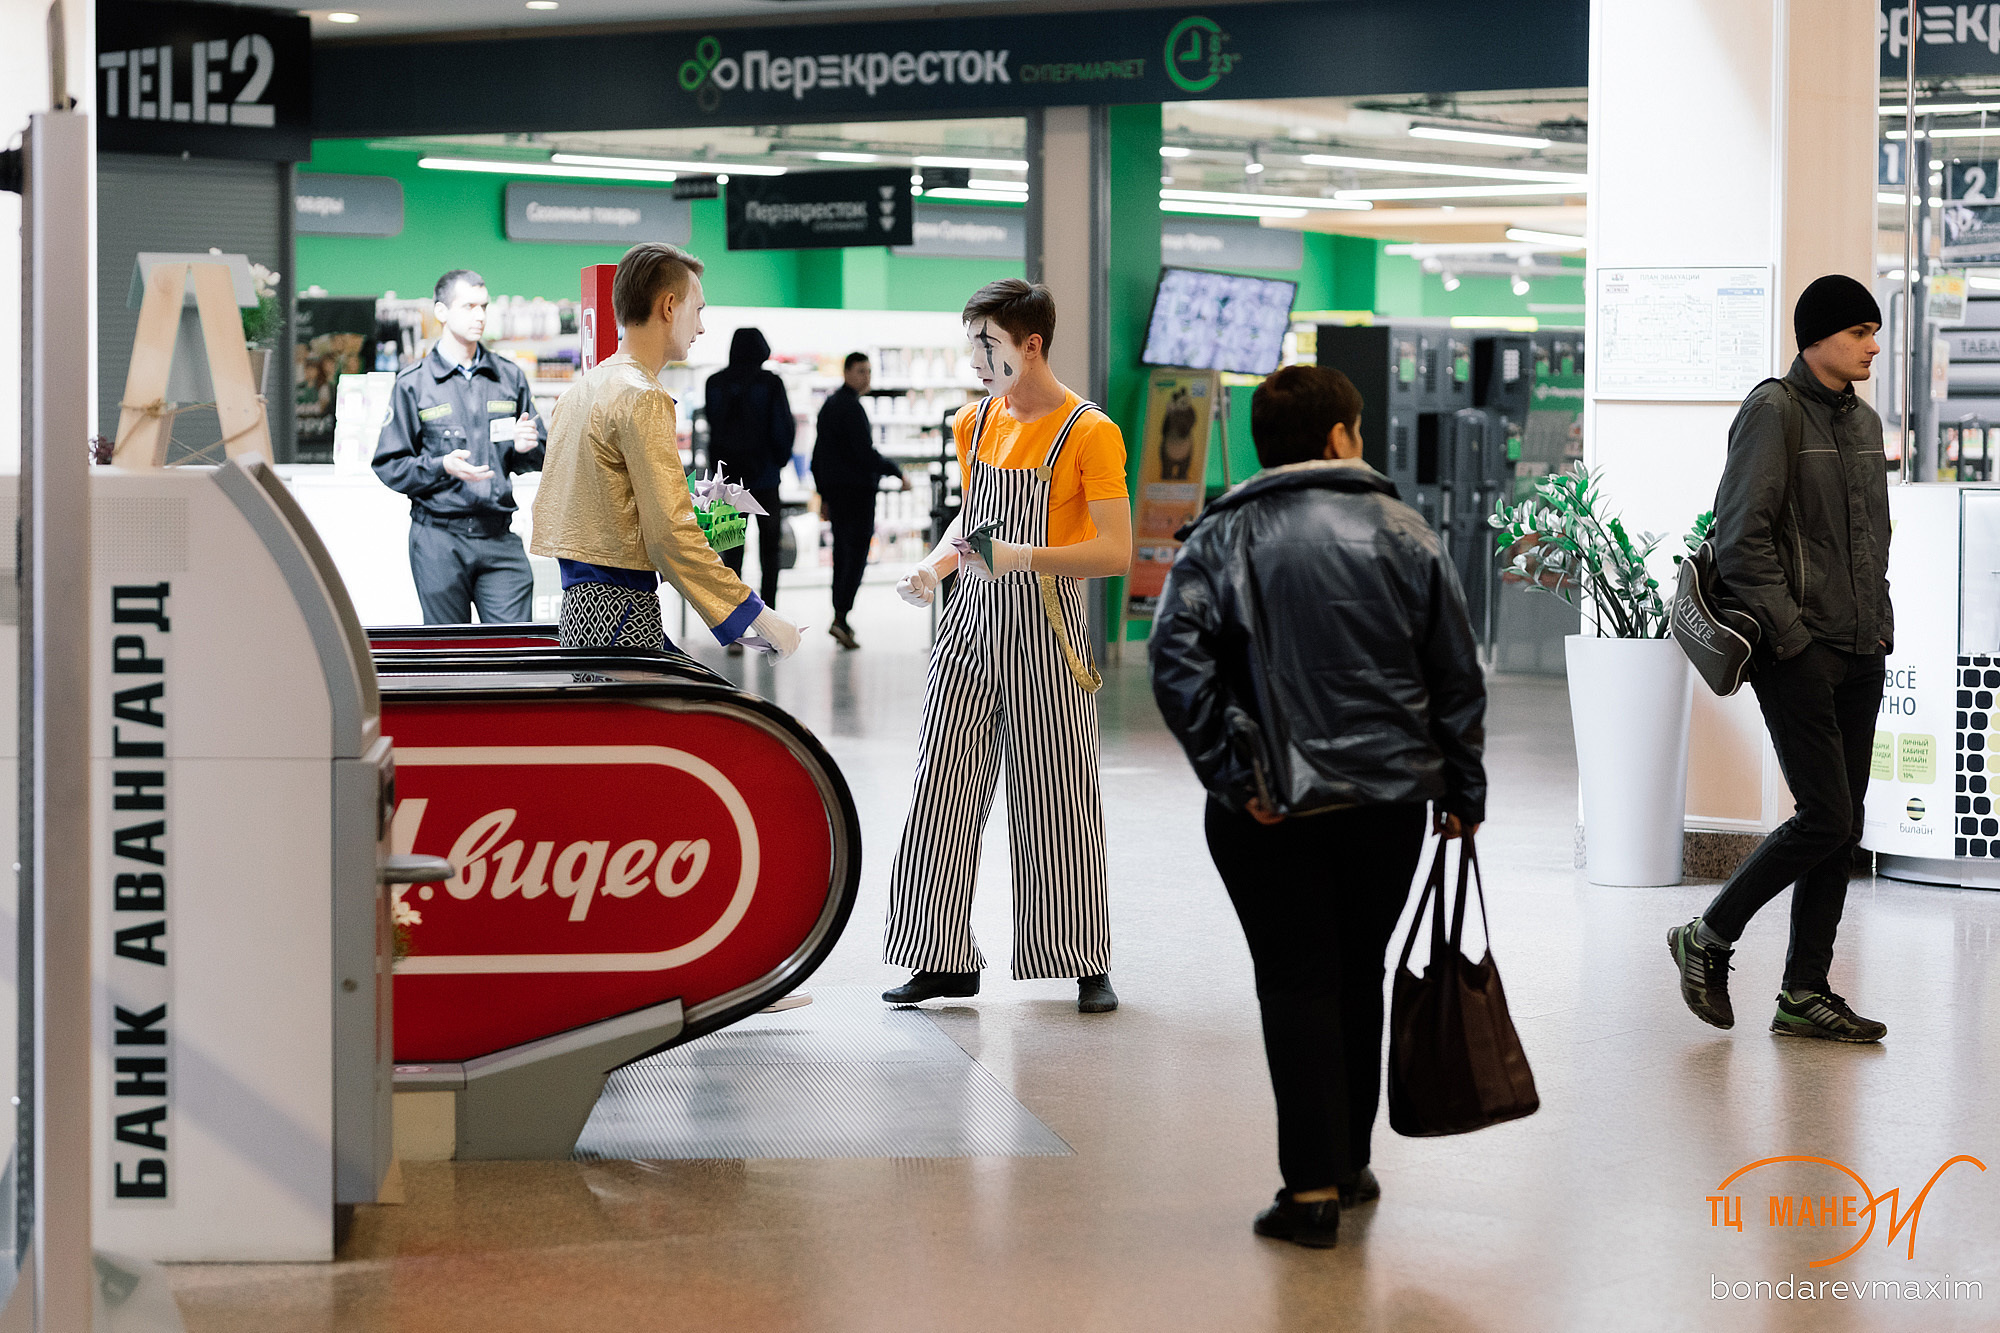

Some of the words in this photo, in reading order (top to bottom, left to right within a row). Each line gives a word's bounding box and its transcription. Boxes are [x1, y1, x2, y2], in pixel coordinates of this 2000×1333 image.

[98, 33, 275, 129] TELE2
[743, 49, 1011, 98] Перекресток
[1883, 143, 1899, 183] 1
[1963, 166, 1987, 201] 2
[1680, 595, 1716, 643] NIKE
[1885, 665, 1917, 689] ВСЁ
[1902, 738, 1929, 747] ЛИЧНЫЙ
[1902, 747, 1929, 756] КАБИНЕТ
[1902, 755, 1928, 764] БИЛАЙН
[112, 582, 170, 967] АВАНГАРД
[1899, 823, 1933, 835] билайн
[114, 1003, 167, 1199] БАНК
